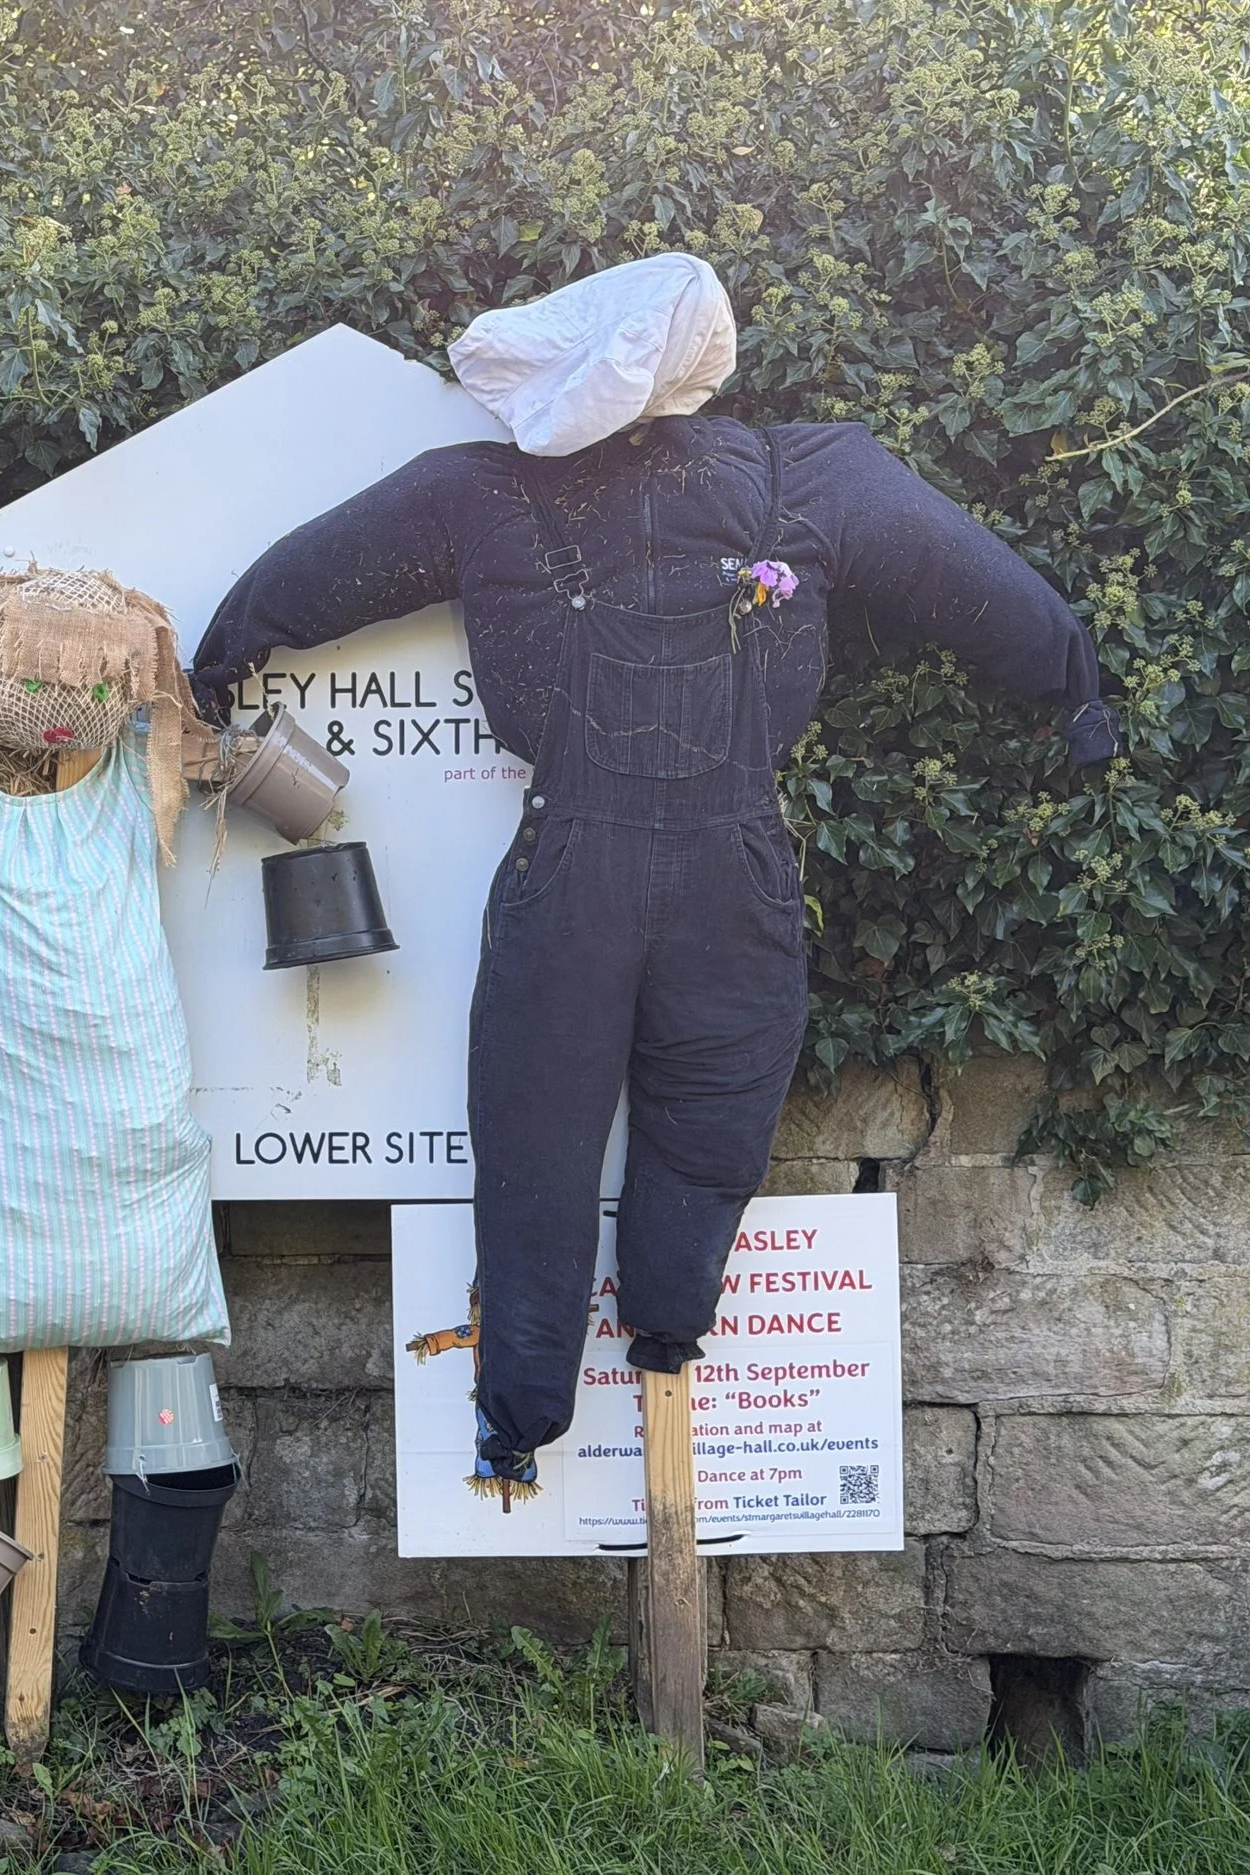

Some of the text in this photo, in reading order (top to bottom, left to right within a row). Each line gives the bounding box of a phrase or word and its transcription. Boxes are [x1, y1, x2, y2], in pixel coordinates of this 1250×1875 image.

[330, 670, 438, 709] HALL
[326, 717, 501, 757] & SIXTH
[444, 766, 527, 783] part of the
[235, 1131, 468, 1165] LOWER SITE
[749, 1270, 873, 1294] FESTIVAL
[595, 1317, 635, 1339] AN
[748, 1313, 843, 1336] DANCE
[583, 1359, 871, 1386] Satur 12th September
[733, 1424, 764, 1437] and
[768, 1423, 804, 1437] map
[806, 1420, 823, 1434] at
[697, 1468, 803, 1484] Dance at 7pm
[694, 1493, 828, 1511] rom Ticket Tailor
